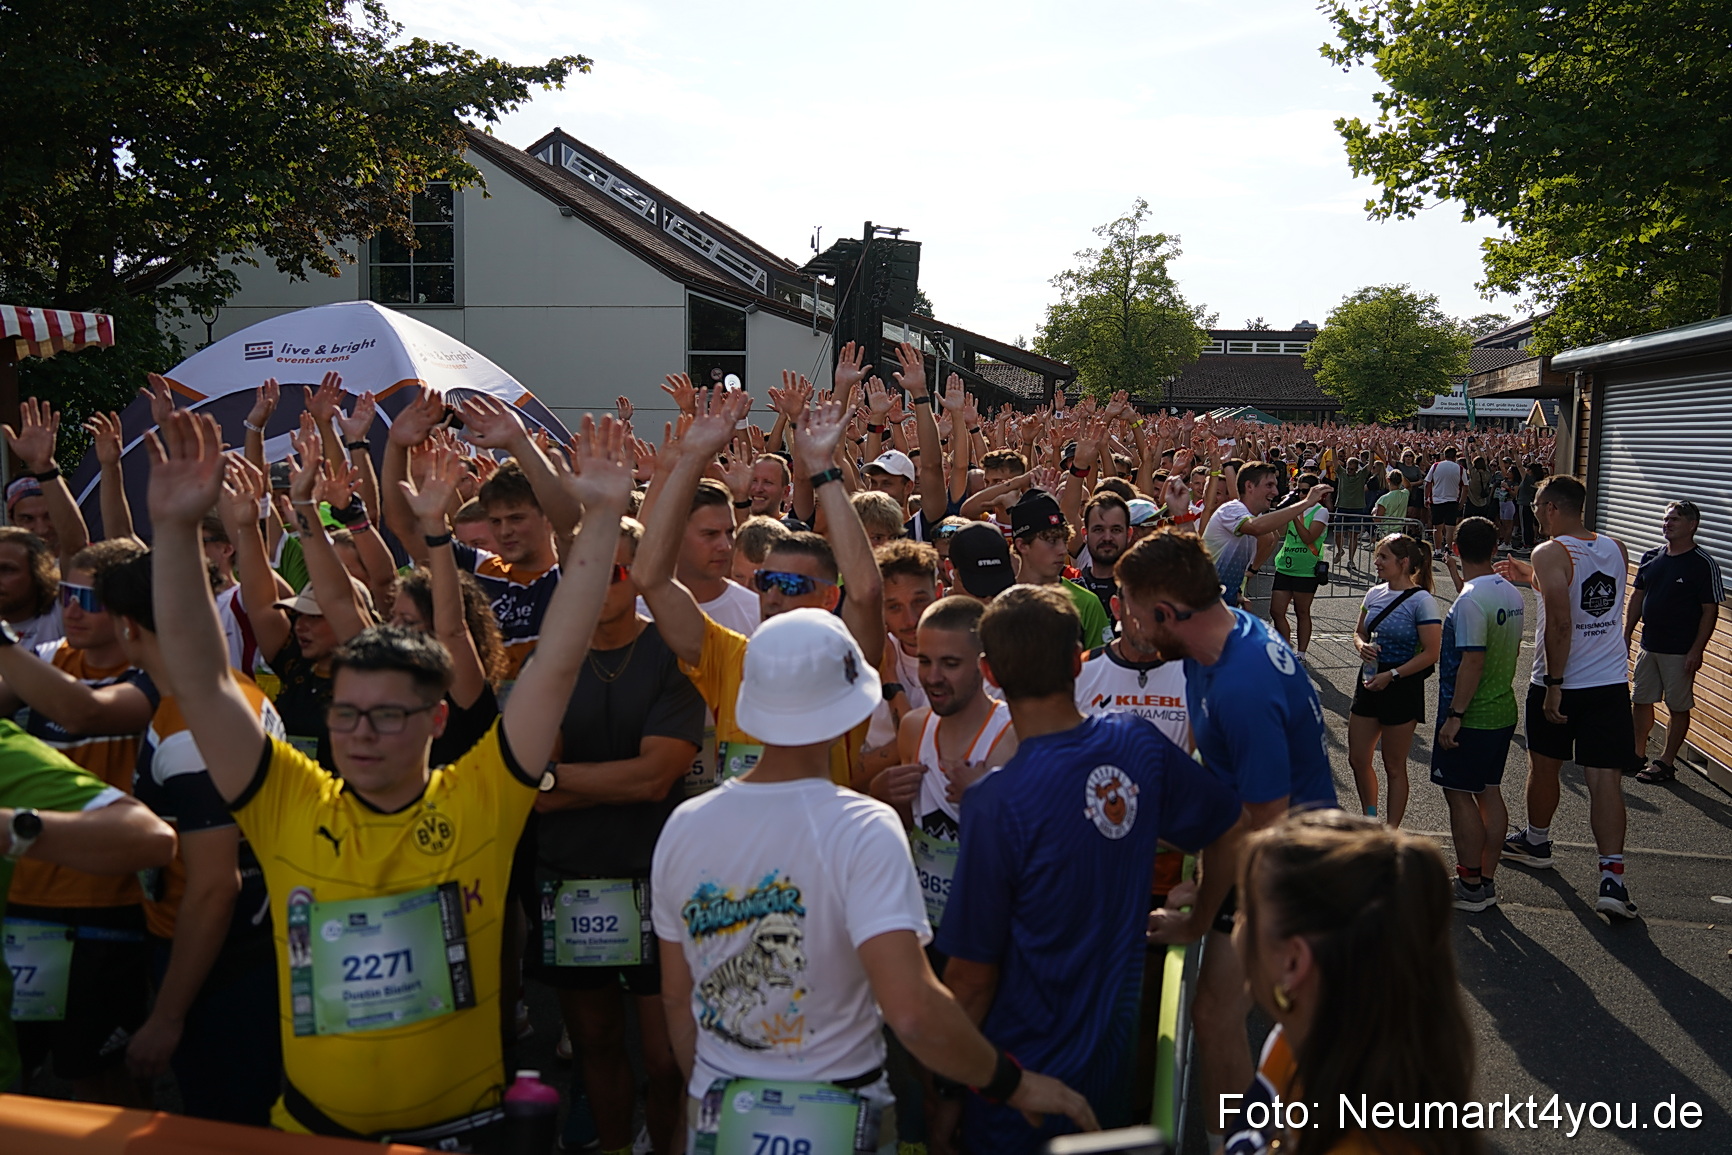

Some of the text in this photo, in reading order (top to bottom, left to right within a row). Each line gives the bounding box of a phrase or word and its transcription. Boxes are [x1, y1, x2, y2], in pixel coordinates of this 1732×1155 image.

[280, 338, 376, 355] live & bright
[276, 354, 350, 364] eventscreens
[1286, 556, 1292, 568] 9
[1116, 695, 1185, 708] KLEBL
[417, 818, 450, 846] BVB
[571, 915, 618, 933] 1932
[342, 948, 413, 982] 2271
[753, 1133, 811, 1155] 708
